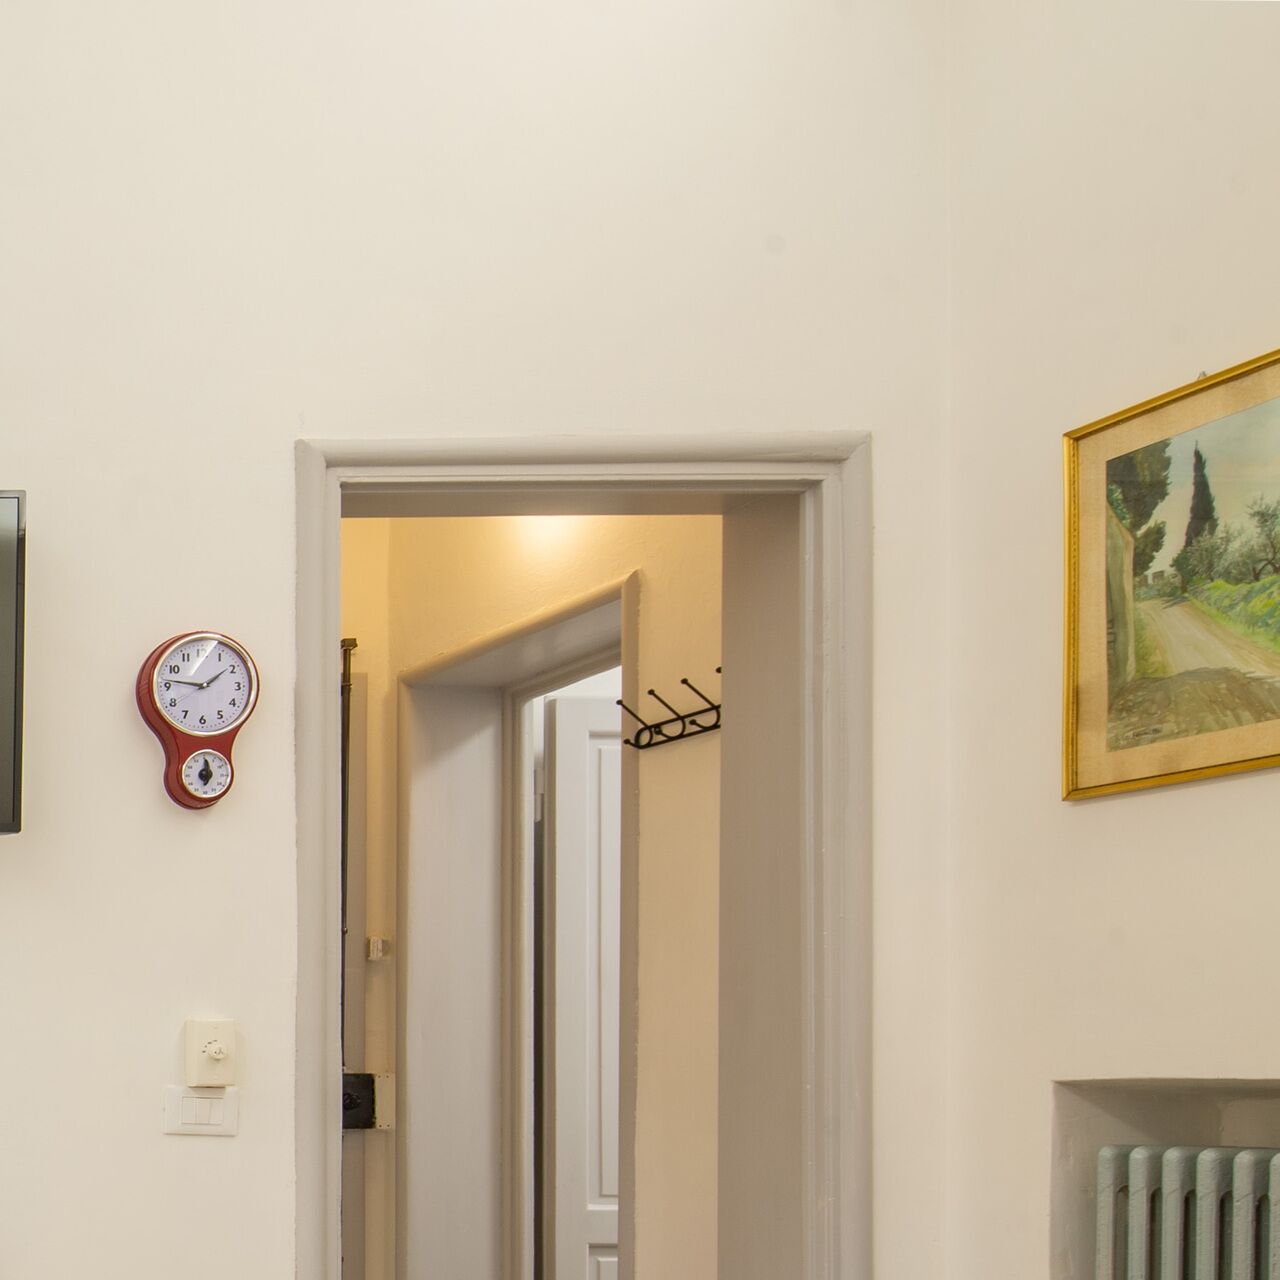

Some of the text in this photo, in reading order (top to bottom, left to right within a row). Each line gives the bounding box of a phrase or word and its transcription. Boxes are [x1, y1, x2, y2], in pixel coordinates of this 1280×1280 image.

[182, 653, 190, 662] 11
[169, 665, 180, 674] 10
[229, 664, 236, 674] 2
[164, 682, 171, 691] 9
[234, 682, 241, 691] 3
[169, 698, 177, 707] 8
[229, 698, 236, 707] 4
[182, 710, 189, 719] 7
[217, 710, 223, 719] 5
[199, 715, 206, 724] 6
